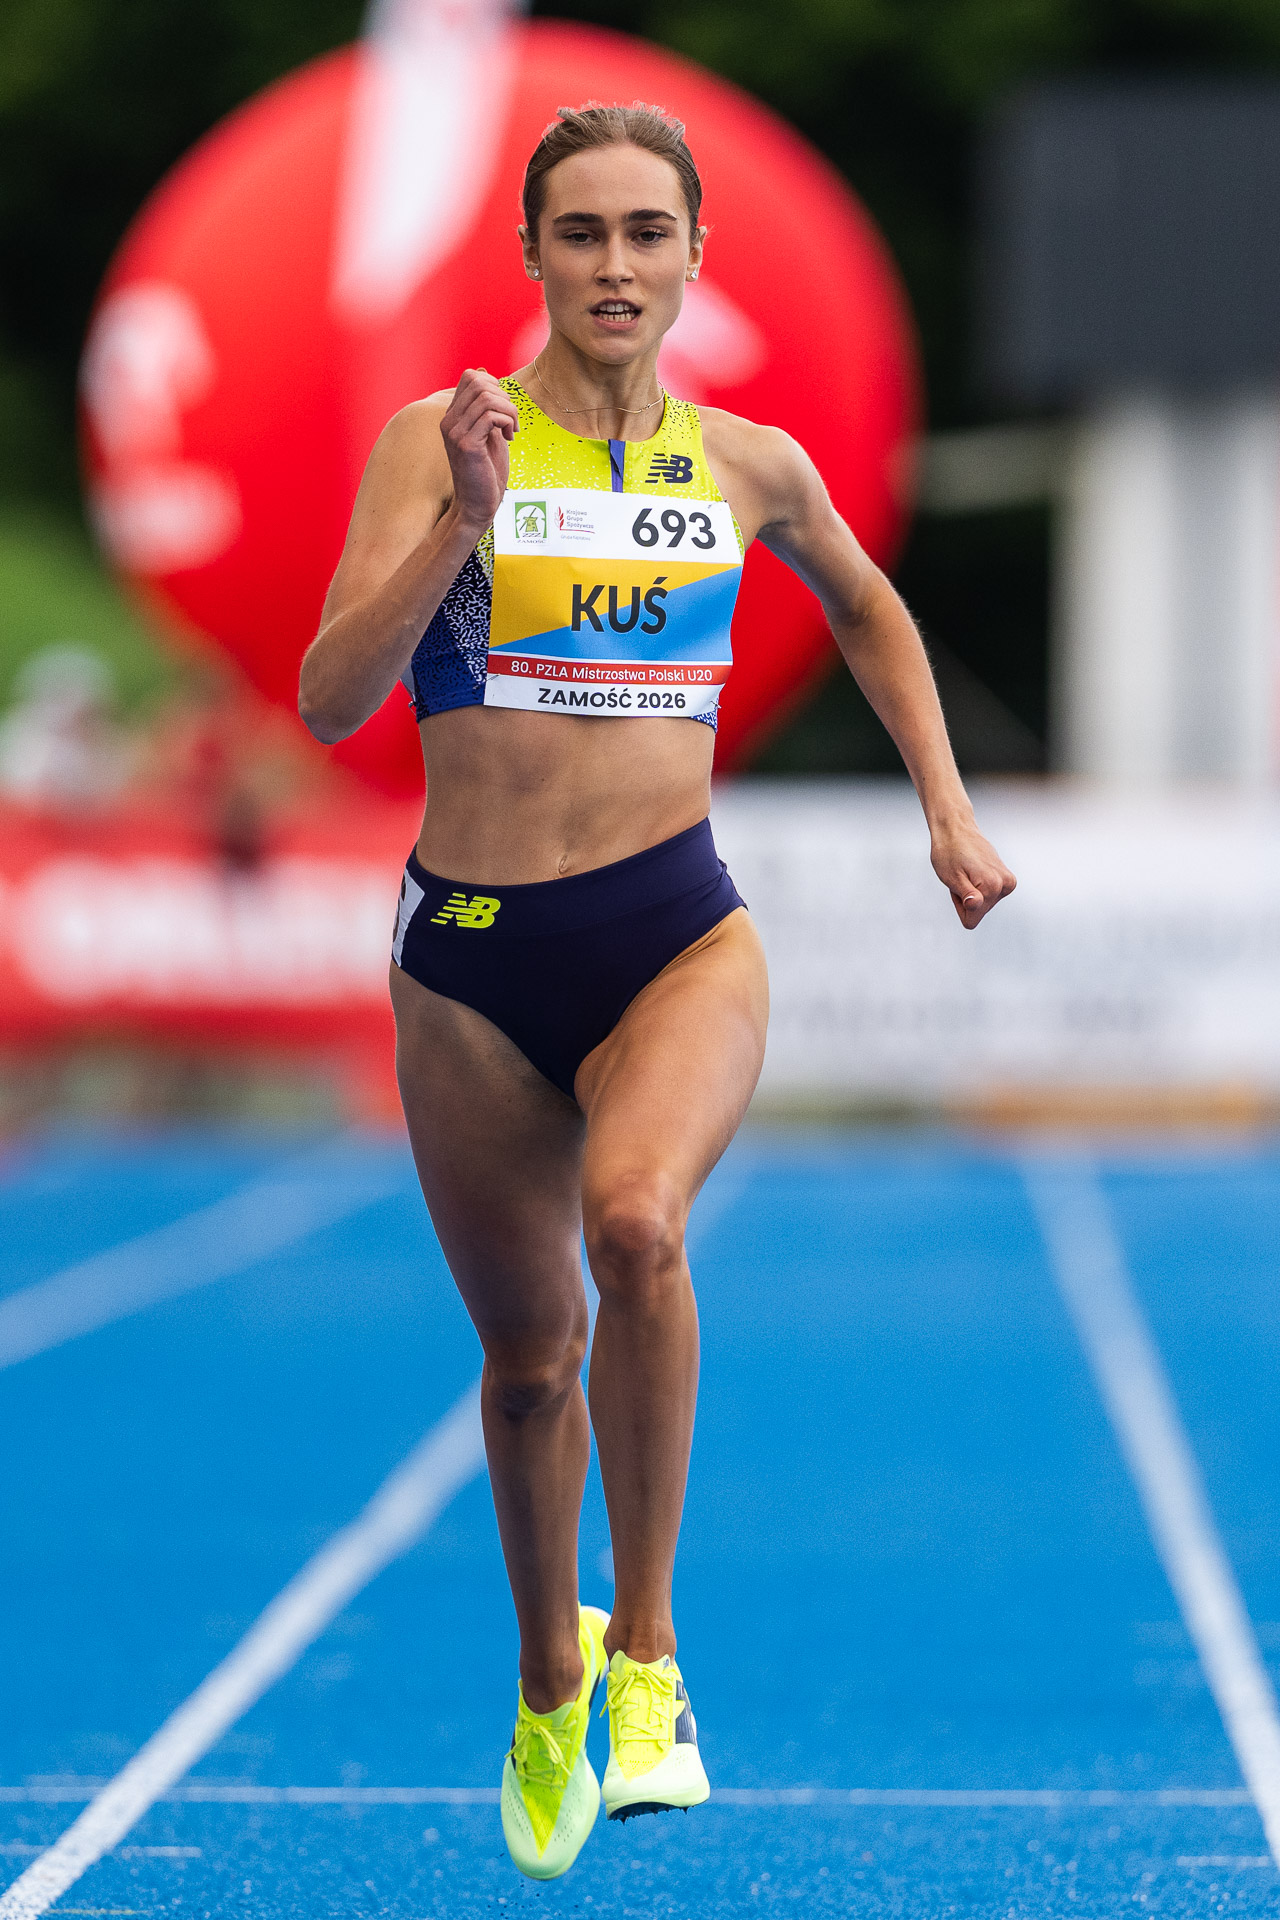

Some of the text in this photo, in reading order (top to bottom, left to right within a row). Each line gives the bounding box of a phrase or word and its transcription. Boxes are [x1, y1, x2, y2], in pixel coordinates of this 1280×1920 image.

[645, 452, 693, 484] NB
[632, 508, 716, 549] 693
[571, 576, 669, 635] KUŚ
[511, 660, 713, 681] 80. PZLA Mistrzostwa Polski U20
[538, 687, 686, 709] ZAMOŚĆ 2026
[430, 892, 501, 929] NB
